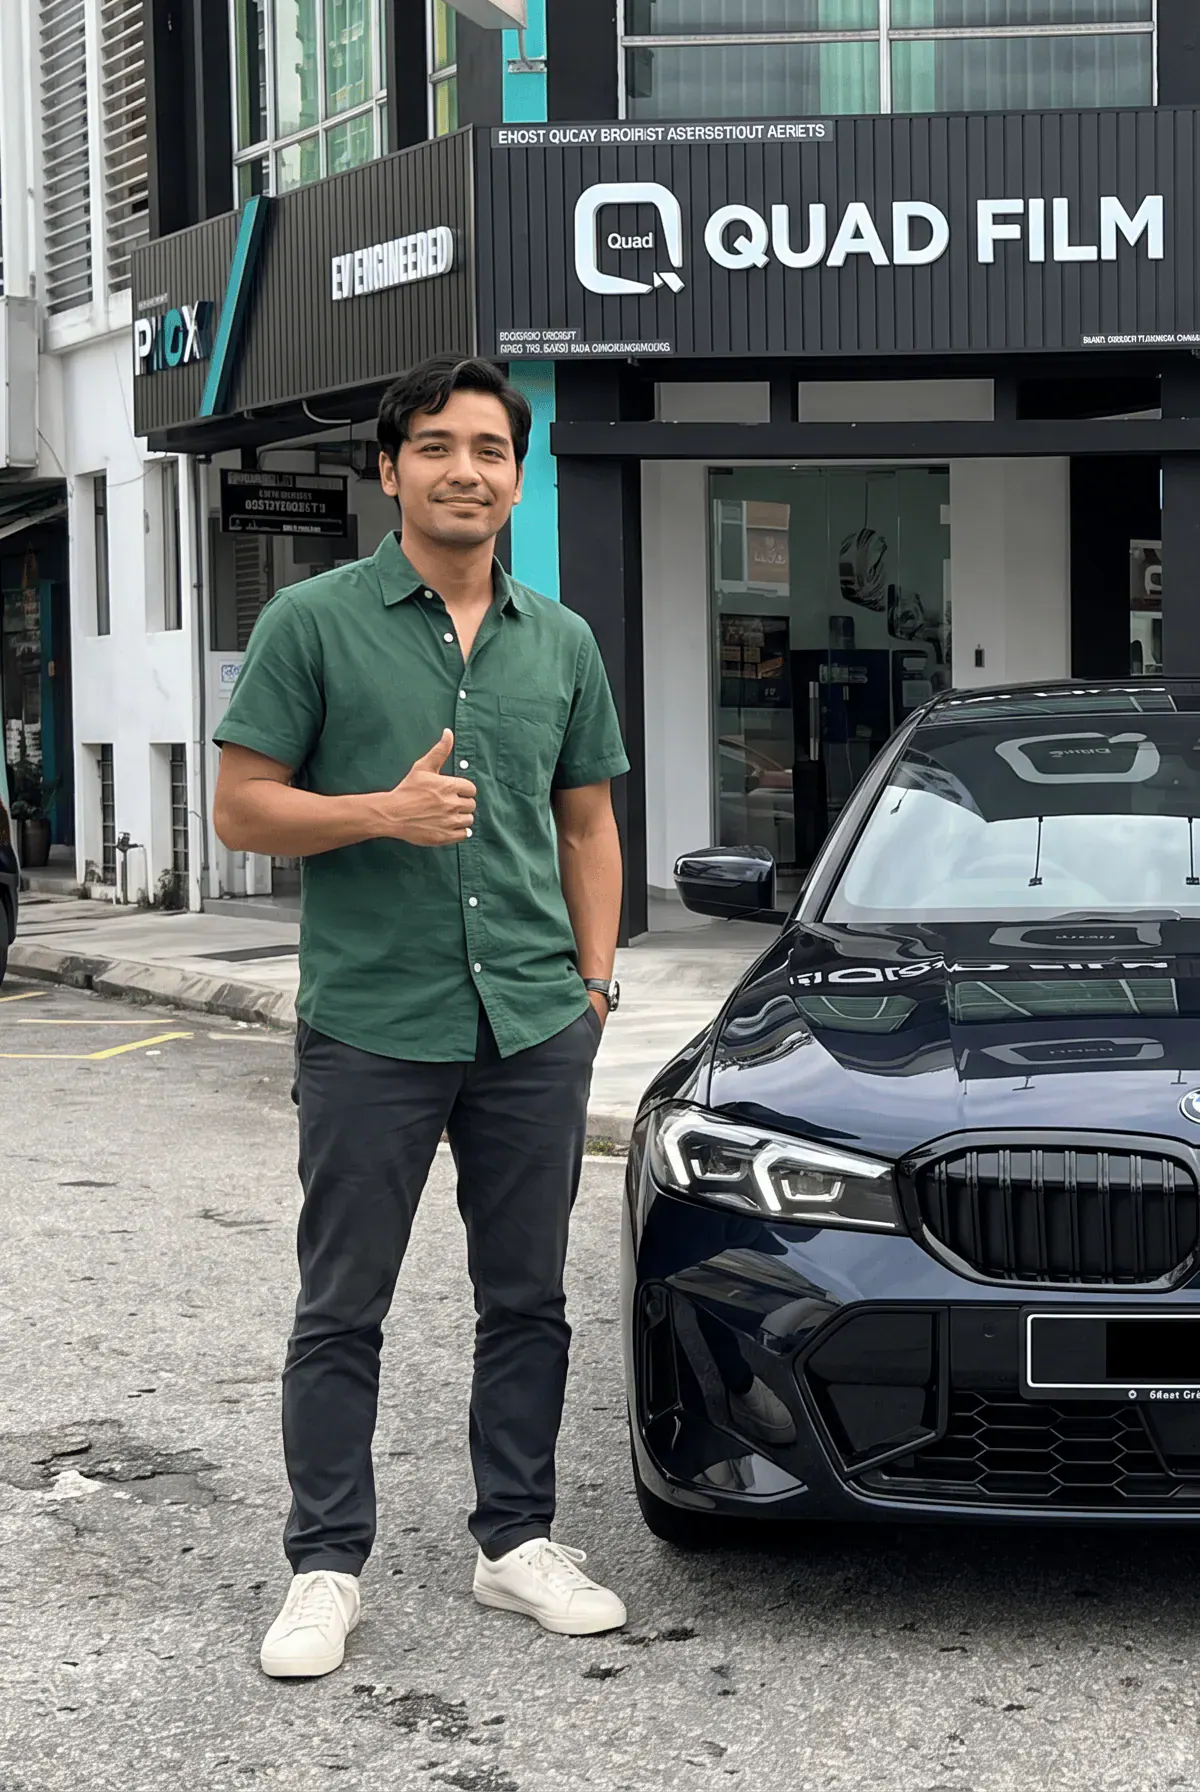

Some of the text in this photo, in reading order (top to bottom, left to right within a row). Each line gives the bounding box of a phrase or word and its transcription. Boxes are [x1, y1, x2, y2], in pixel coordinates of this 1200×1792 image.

[549, 128, 598, 144] QUCAY
[607, 232, 653, 250] Quad
[704, 195, 1164, 270] QUAD FILM
[332, 226, 454, 300] EV ENGINEERED
